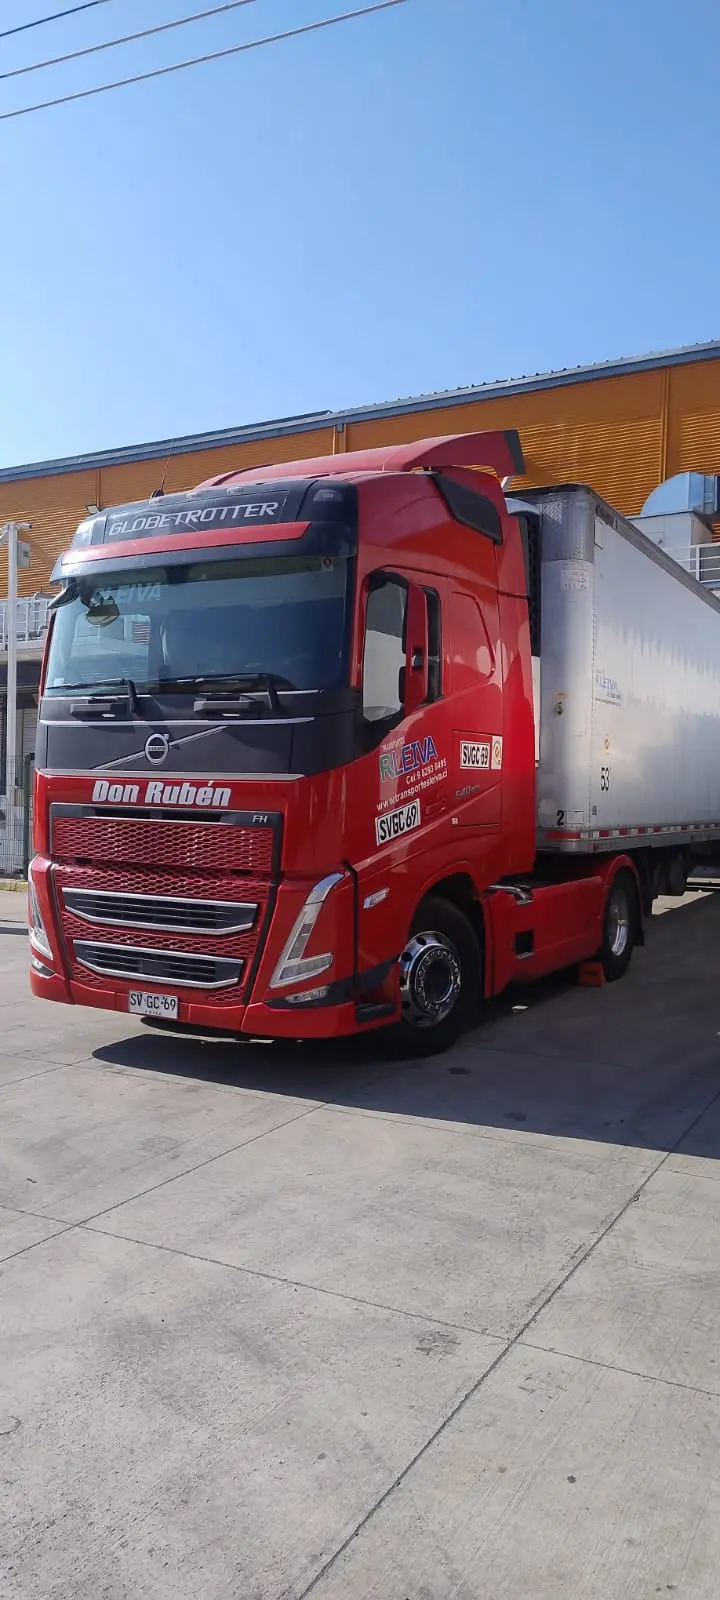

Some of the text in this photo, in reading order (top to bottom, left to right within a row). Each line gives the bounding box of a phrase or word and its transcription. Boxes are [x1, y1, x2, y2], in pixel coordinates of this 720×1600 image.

[109, 501, 280, 536] GLOBETROTTER
[380, 736, 438, 783] RLEIVA
[463, 744, 488, 765] SVGC 69
[92, 780, 232, 807] Don Rubén
[252, 814, 268, 824] FH
[379, 805, 418, 841] SVGC 69
[556, 810, 565, 826] 2
